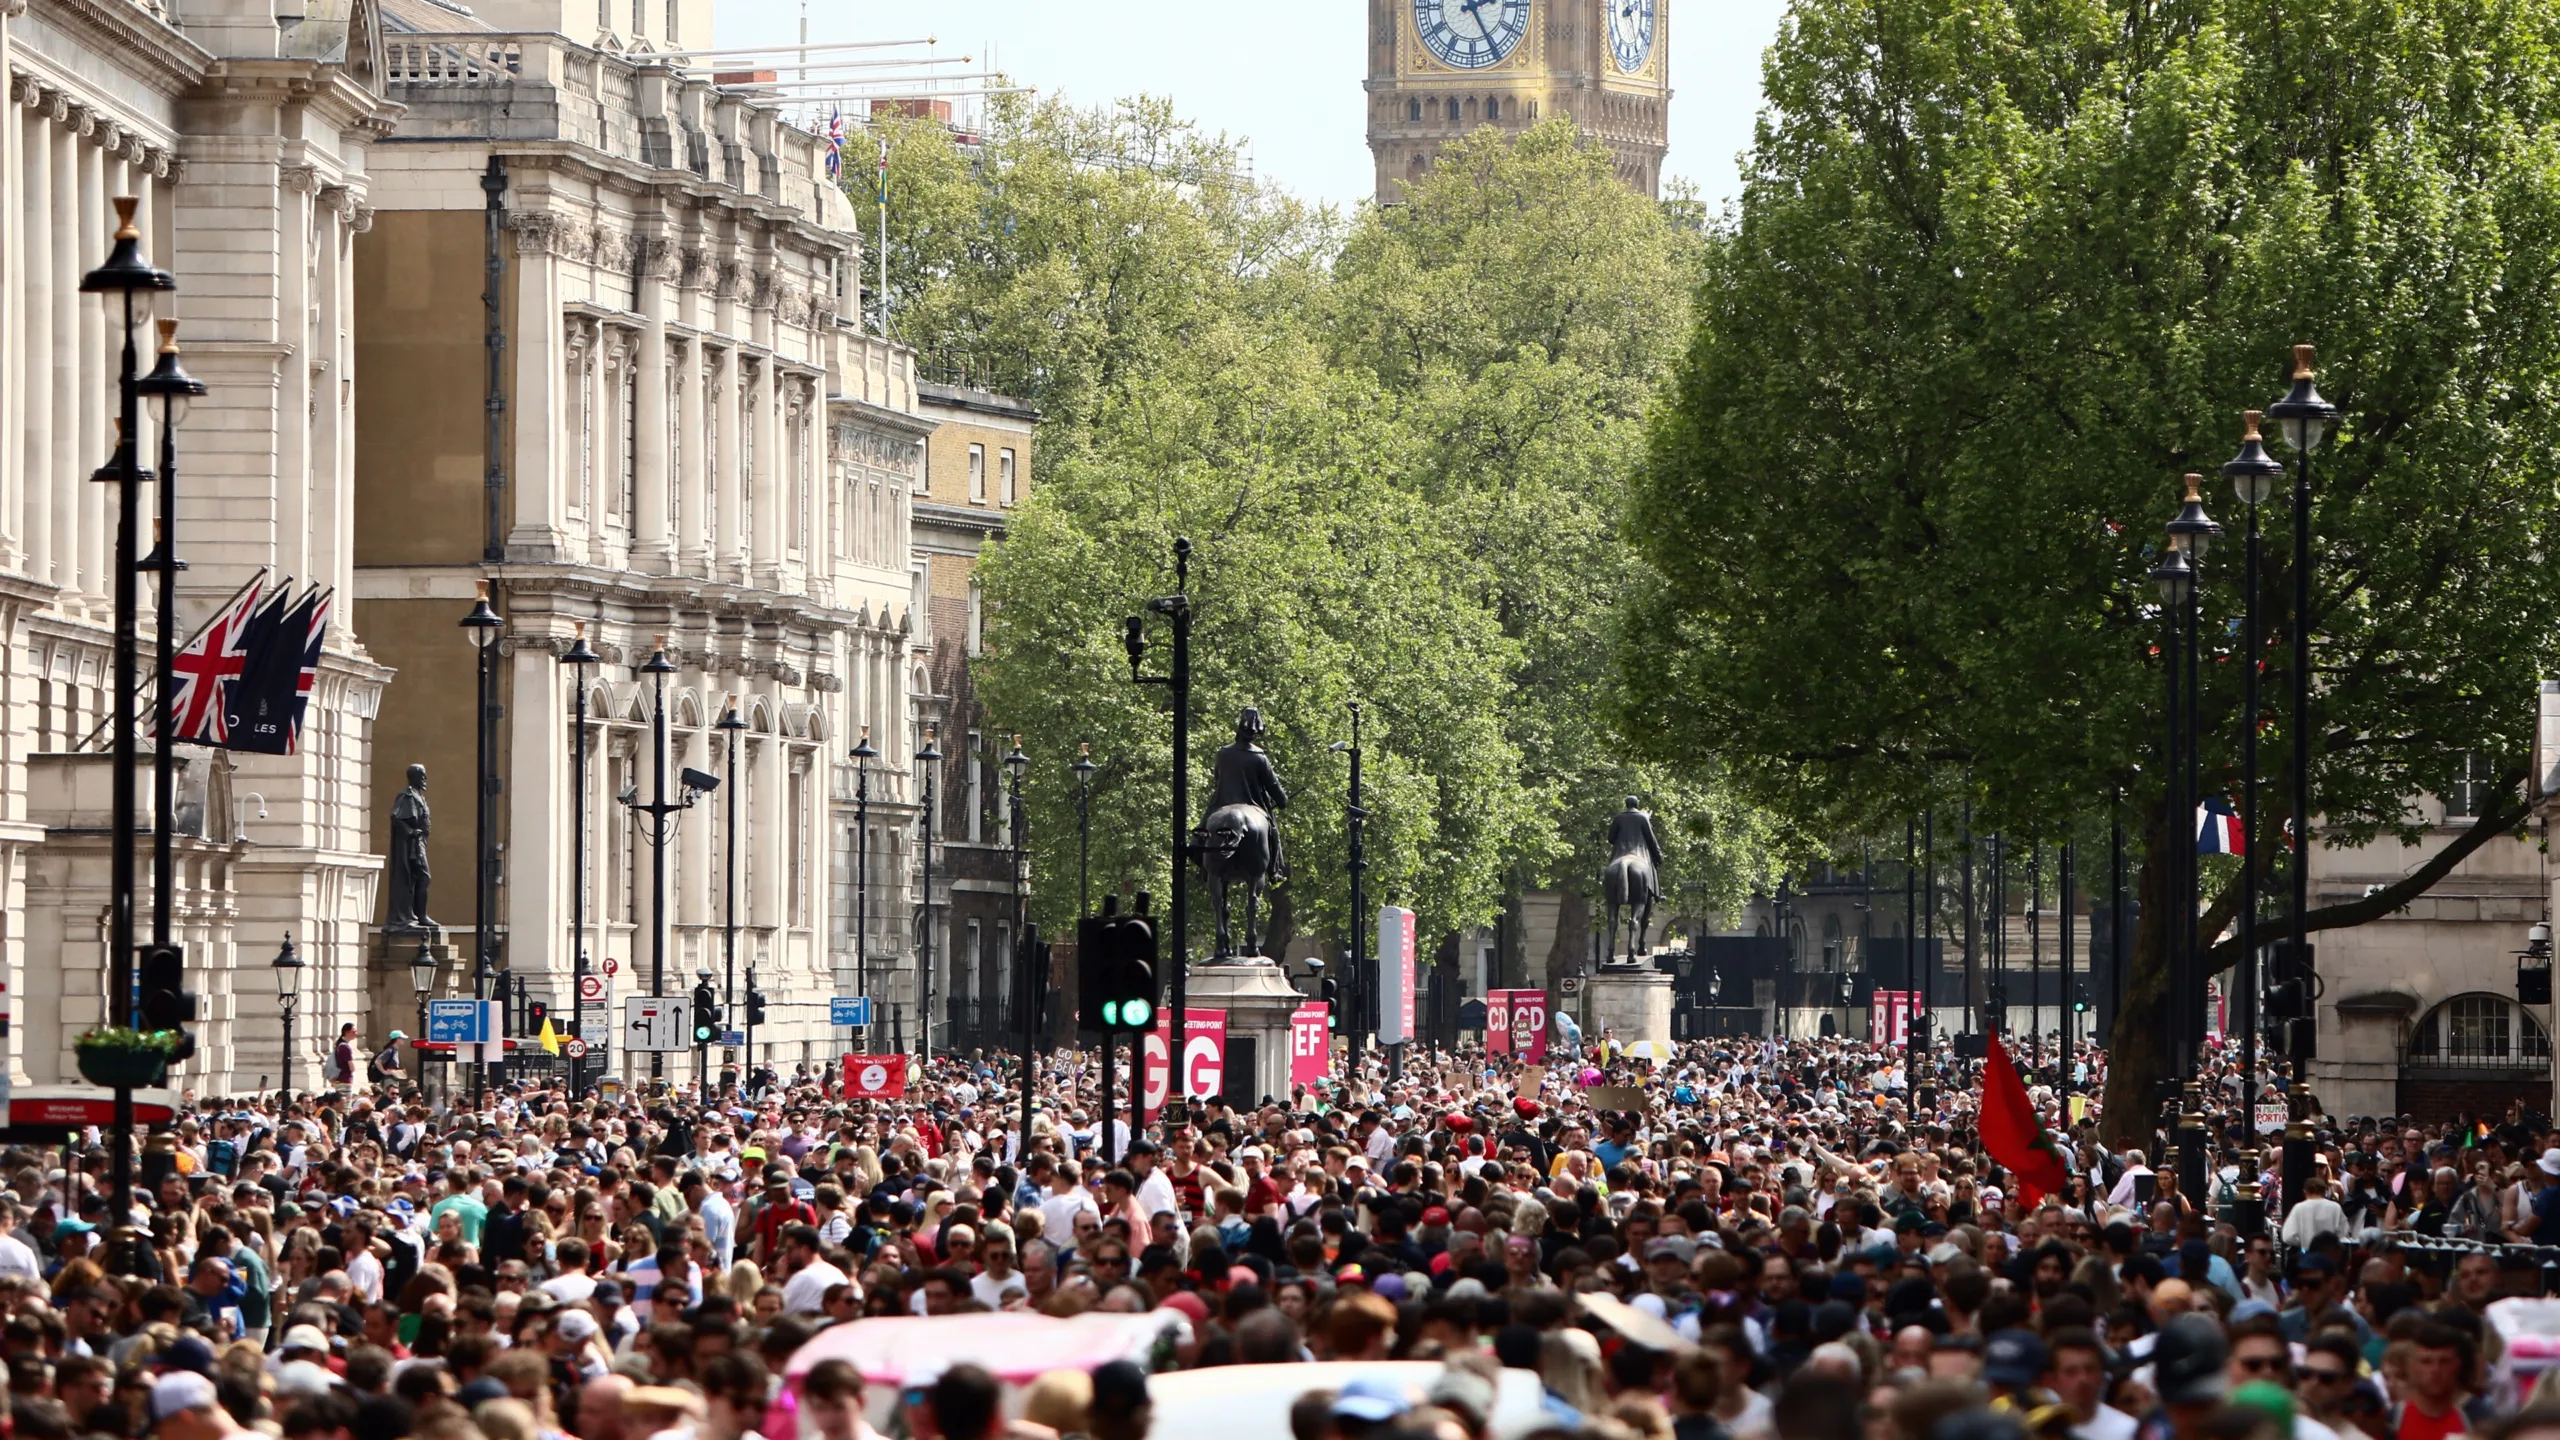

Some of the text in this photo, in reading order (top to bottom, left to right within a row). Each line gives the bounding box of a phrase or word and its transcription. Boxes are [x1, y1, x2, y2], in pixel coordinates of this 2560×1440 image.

[606, 959, 615, 973] P
[1311, 1010, 1327, 1019] POINT
[1488, 1006, 1508, 1032] CD
[1206, 1020, 1224, 1030] POINT
[1875, 1004, 1886, 1044] B
[1295, 1023, 1323, 1057] EF
[569, 1043, 584, 1053] 20
[1057, 1048, 1073, 1060] GO
[1054, 1058, 1077, 1074] BEN
[1183, 1035, 1221, 1110] G
